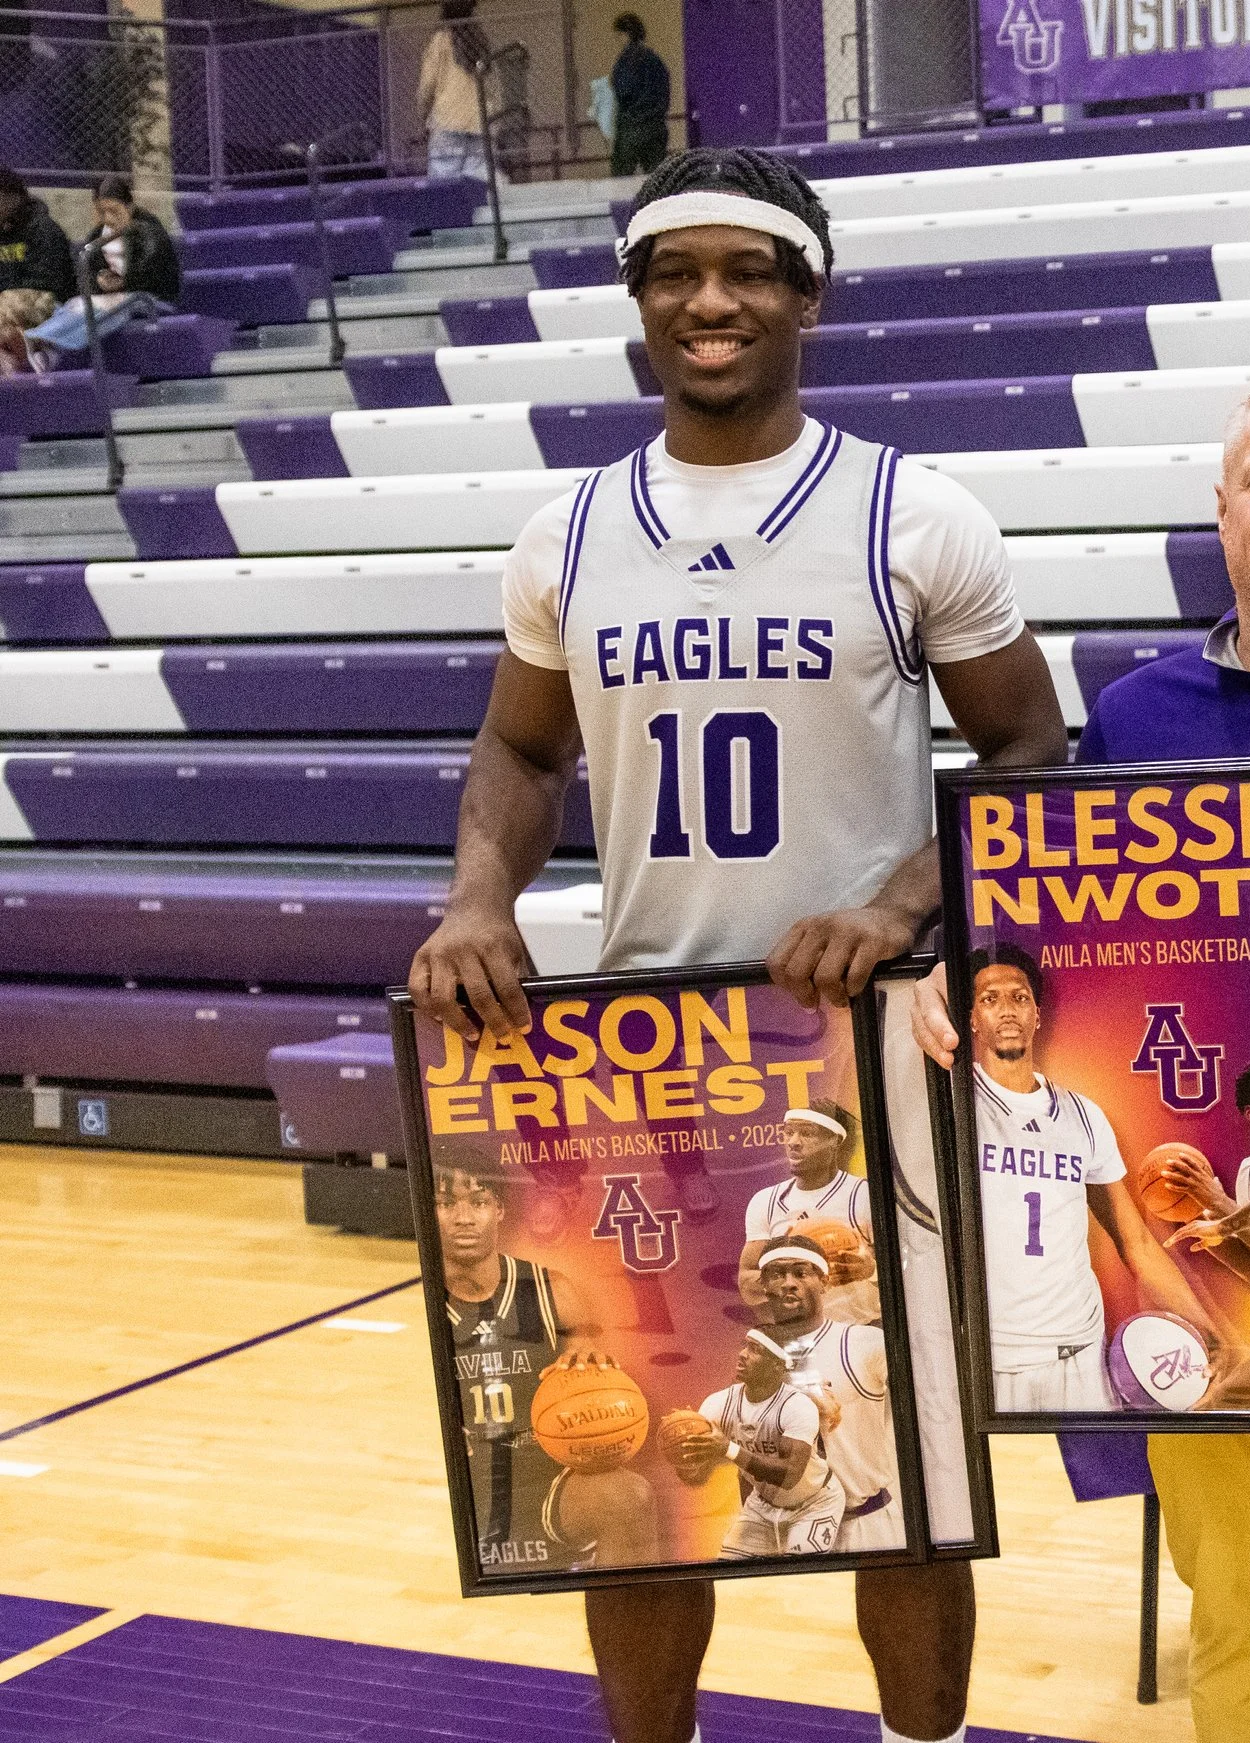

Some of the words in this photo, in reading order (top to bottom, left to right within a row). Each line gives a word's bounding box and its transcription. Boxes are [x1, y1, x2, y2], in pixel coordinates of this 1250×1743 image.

[595, 615, 834, 690] EAGLES
[643, 706, 785, 863] 10
[1040, 943, 1092, 969] AVILA
[1096, 940, 1152, 967] MEN'S
[425, 986, 753, 1086] JASON
[1130, 1003, 1225, 1114] AU
[427, 1059, 826, 1135] ERNEST
[500, 1140, 550, 1165] AVILA
[554, 1135, 607, 1161] MEN'S
[611, 1129, 724, 1158] BASKETBALL
[741, 1123, 786, 1148] 2025
[982, 1143, 1083, 1183] EAGLES
[591, 1173, 681, 1274] AU
[1023, 1191, 1044, 1257] 1
[469, 1383, 515, 1425] 10
[556, 1400, 637, 1432] SPALDING
[479, 1540, 549, 1565] EAGLES
